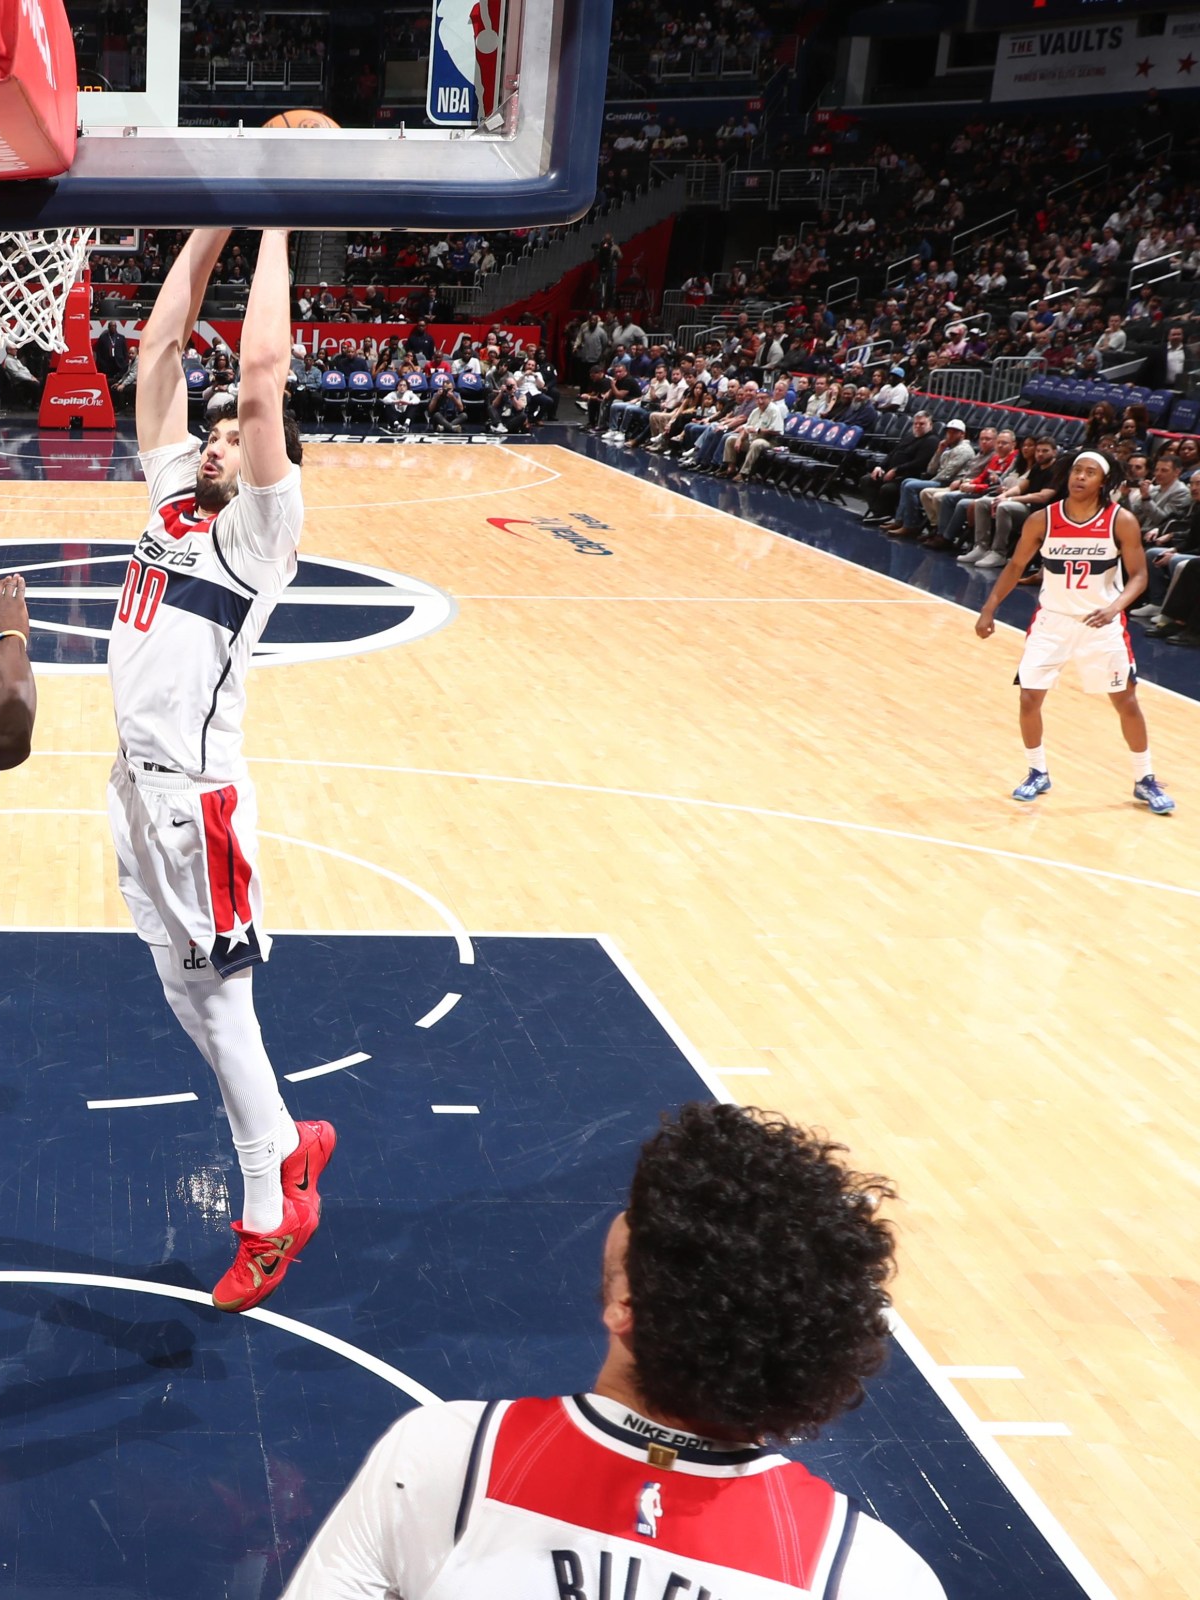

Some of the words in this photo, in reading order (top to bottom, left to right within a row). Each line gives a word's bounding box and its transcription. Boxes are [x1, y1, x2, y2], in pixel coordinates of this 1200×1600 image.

[1011, 40, 1034, 53] THE
[1040, 26, 1123, 56] VAULTS
[437, 87, 470, 113] NBA
[50, 395, 103, 407] CapitalOne
[1048, 543, 1108, 556] wizards
[1063, 560, 1092, 590] 12
[118, 559, 168, 633] 00
[622, 1414, 668, 1443] NIKE
